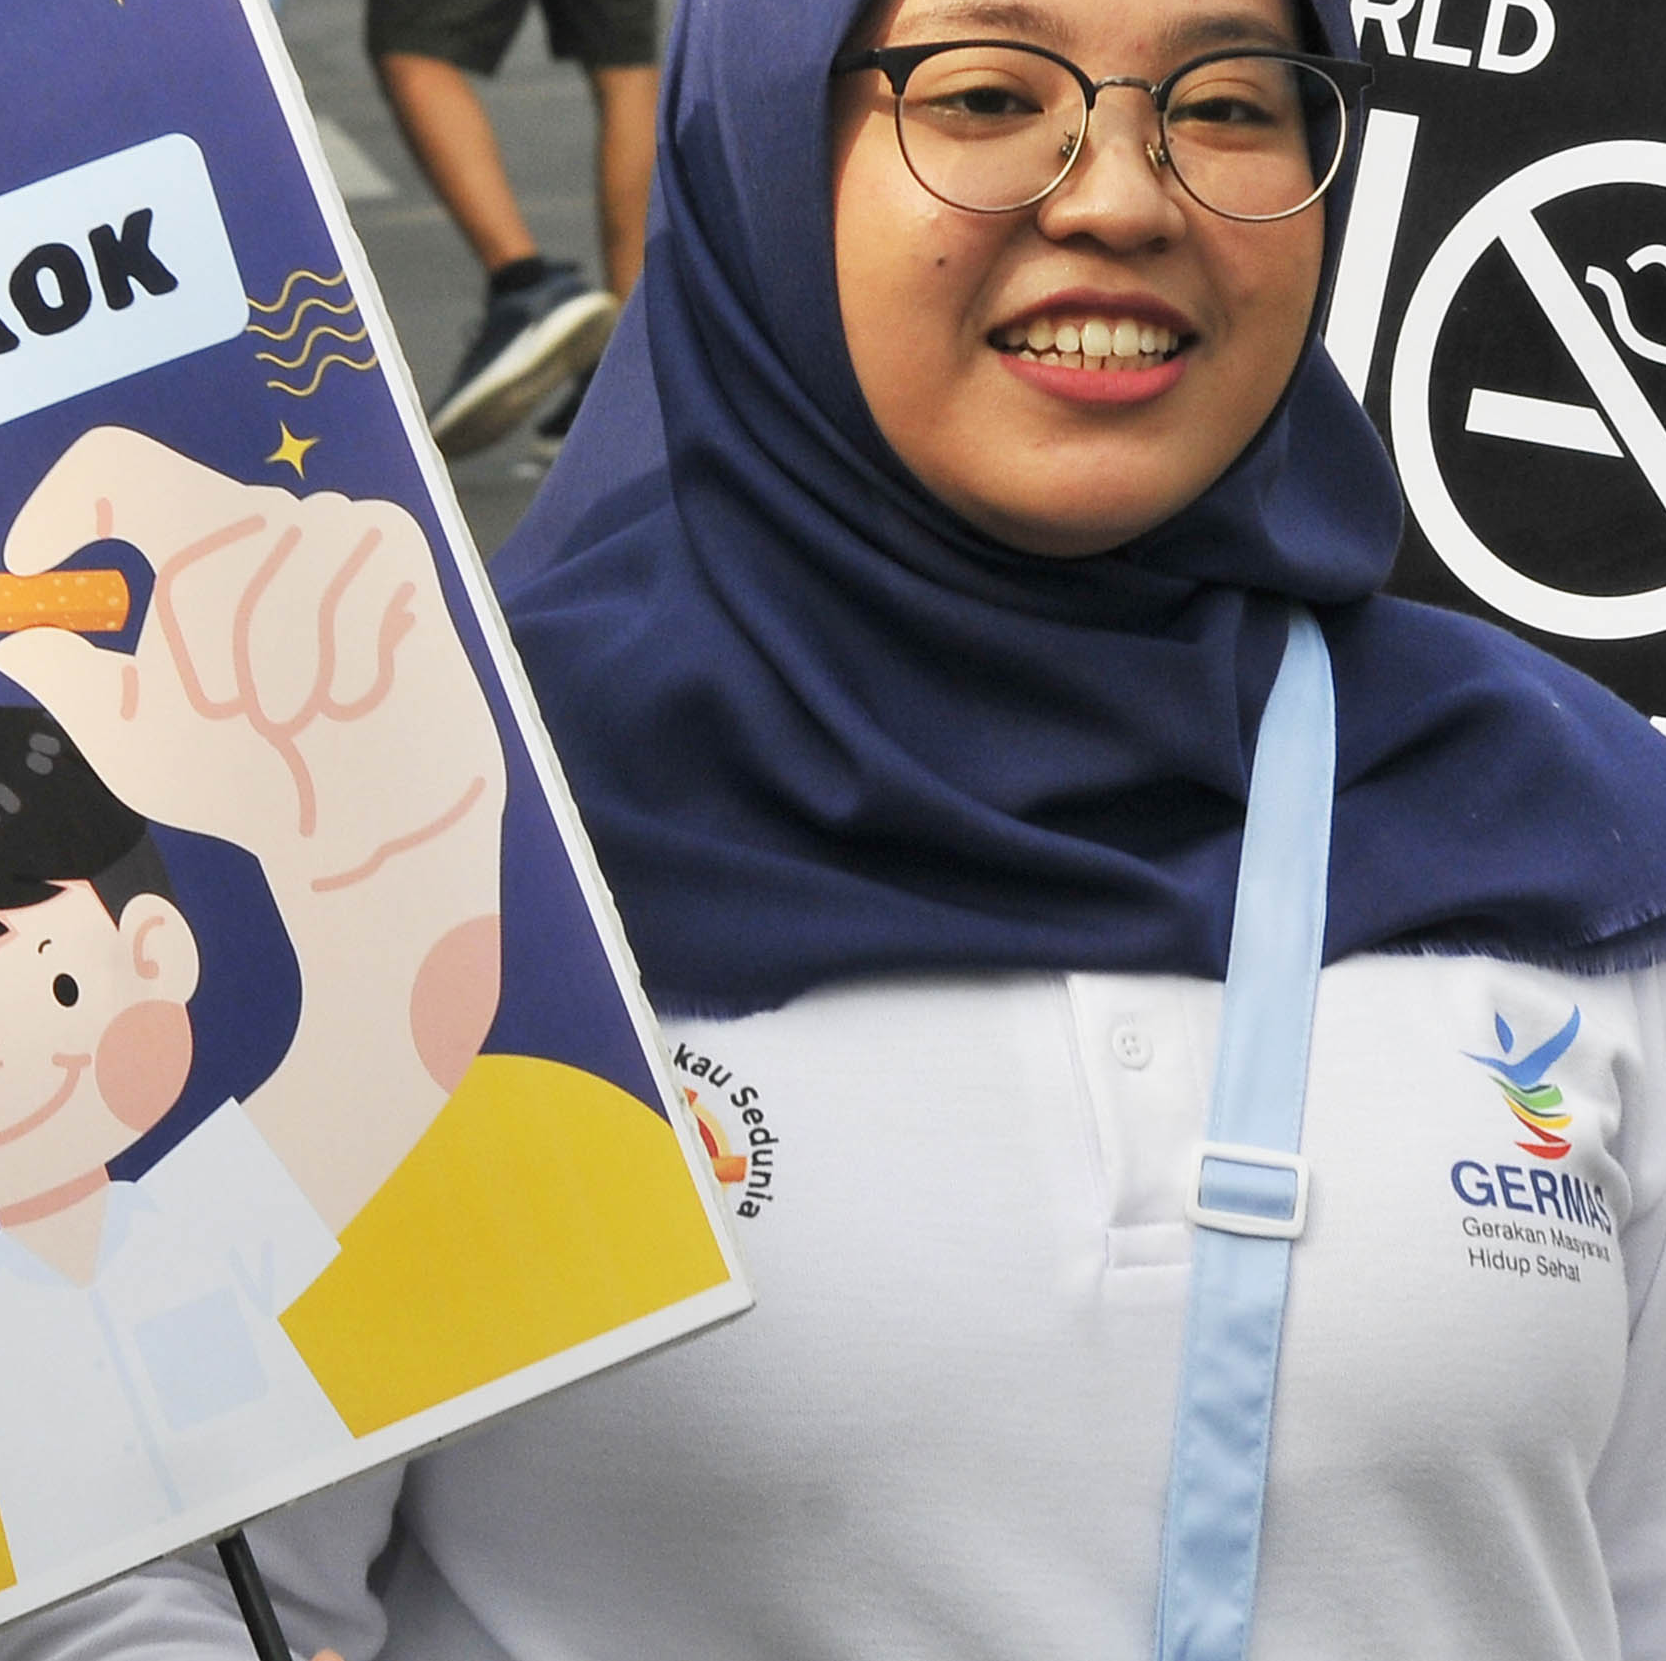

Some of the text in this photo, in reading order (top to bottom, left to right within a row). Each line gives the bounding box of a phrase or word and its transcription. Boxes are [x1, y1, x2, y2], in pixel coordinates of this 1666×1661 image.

[673, 1042, 733, 1089] kau
[1450, 1159, 1613, 1236] GERMAS
[1462, 1216, 1548, 1246] Gerakan
[1467, 1246, 1582, 1283] Hidup Sehat
